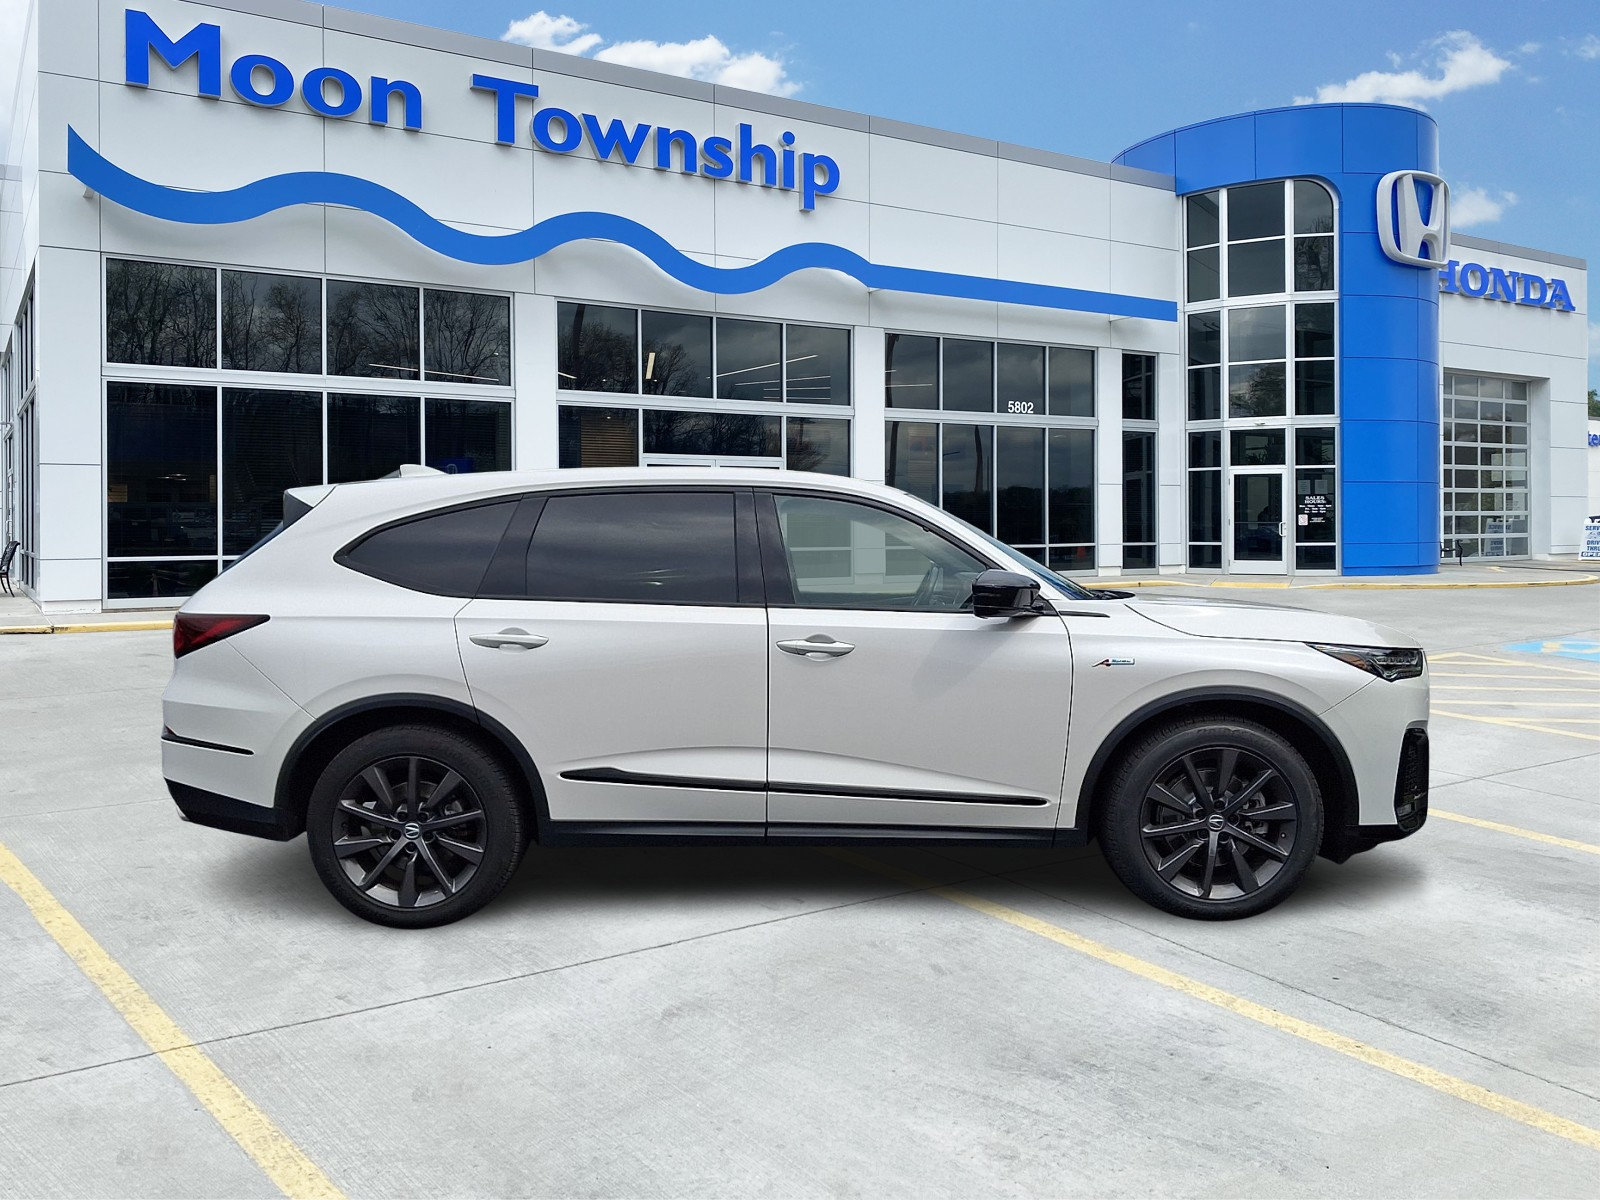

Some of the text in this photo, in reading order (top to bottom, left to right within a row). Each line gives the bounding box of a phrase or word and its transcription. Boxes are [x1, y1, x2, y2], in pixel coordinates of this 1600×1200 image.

[125, 9, 841, 212] Moon Township
[1007, 400, 1034, 414] 5802
